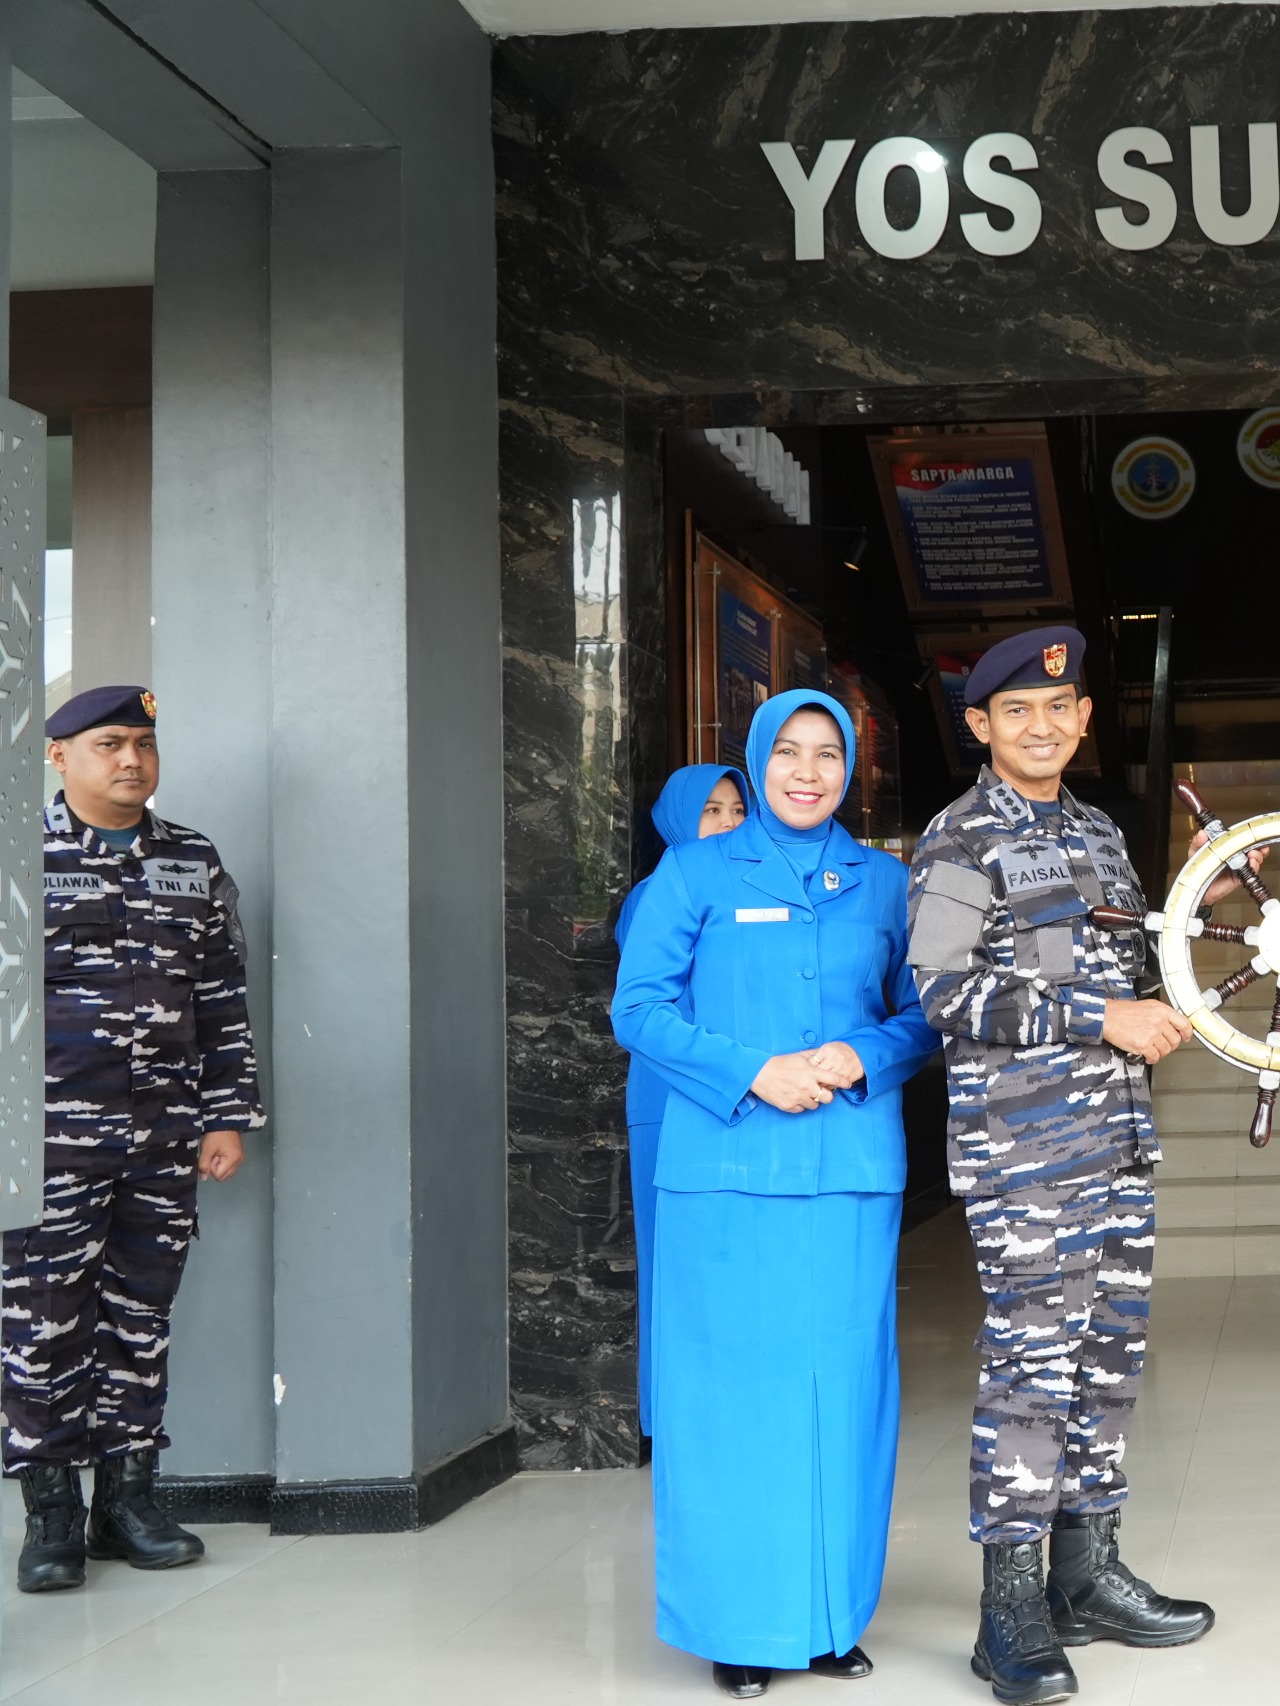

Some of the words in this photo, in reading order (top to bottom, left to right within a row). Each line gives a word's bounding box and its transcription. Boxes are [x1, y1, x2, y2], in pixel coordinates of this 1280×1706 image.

[760, 133, 1042, 261] YOS
[911, 469, 957, 482] SAPTA
[961, 467, 1015, 481] MARGA
[1007, 866, 1069, 887] FAISAL
[1099, 863, 1118, 877] TNI
[1119, 866, 1129, 879] AL
[155, 880, 181, 891] TNI
[189, 882, 206, 894] AL
